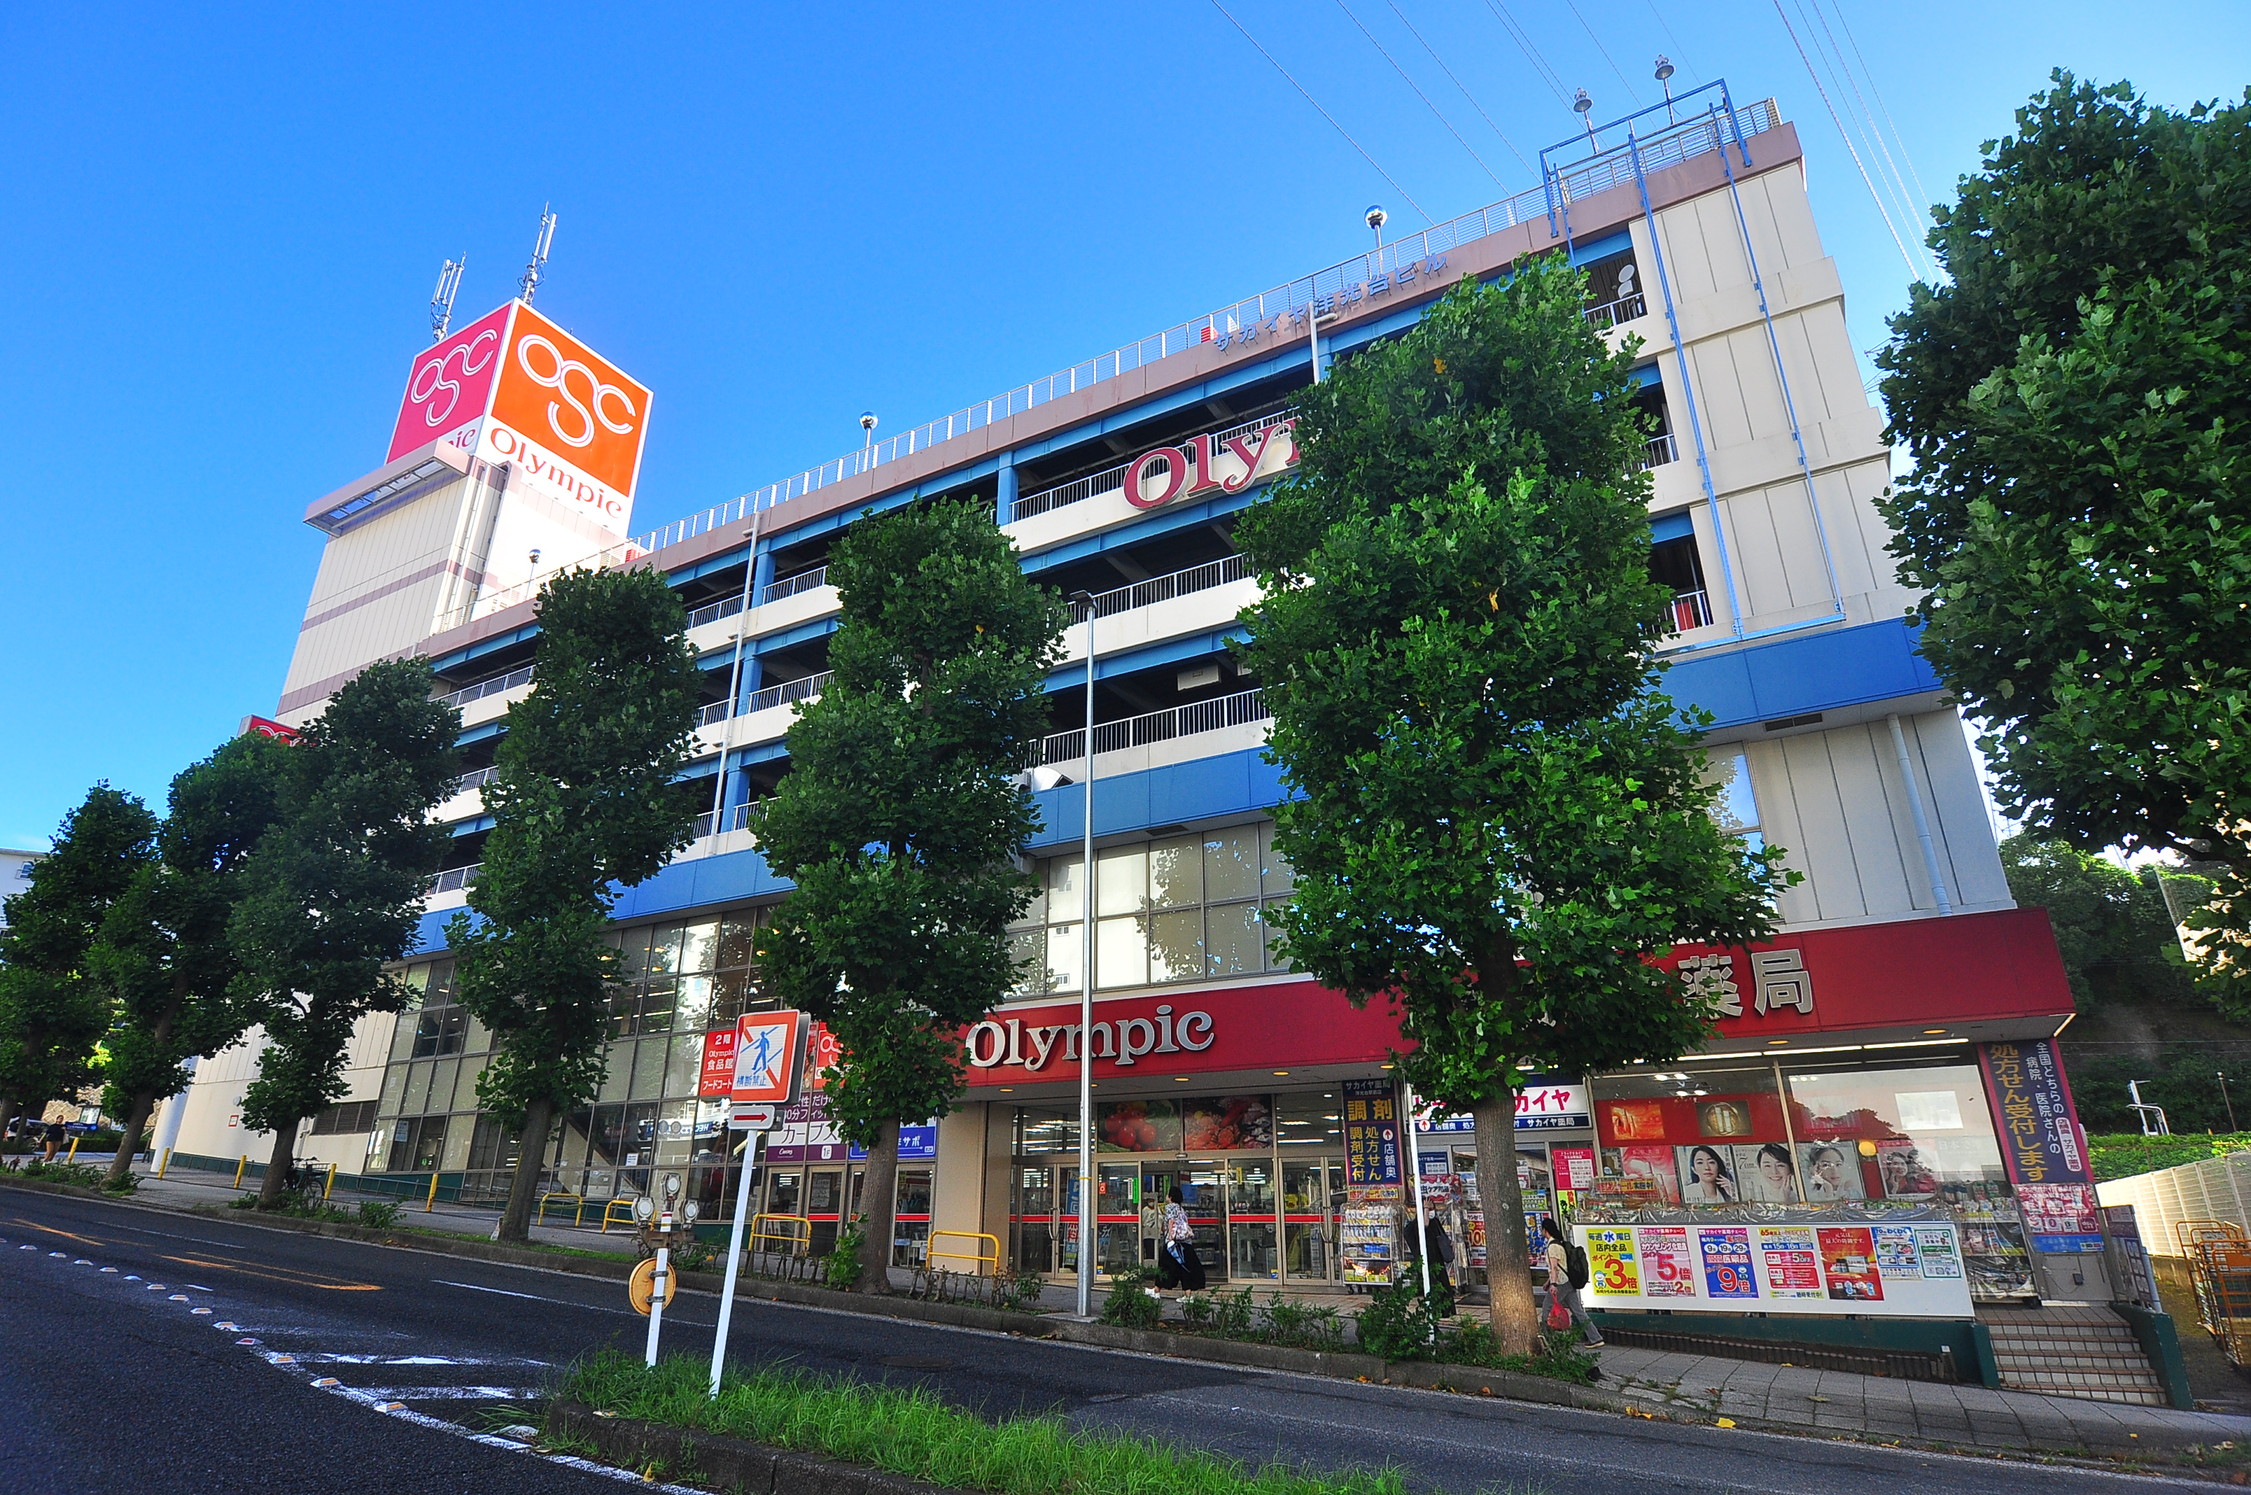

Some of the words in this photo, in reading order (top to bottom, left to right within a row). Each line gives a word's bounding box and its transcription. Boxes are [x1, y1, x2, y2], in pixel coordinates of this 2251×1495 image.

[490, 427, 623, 519] Olympic
[714, 1033, 731, 1045] 2階
[965, 1004, 1215, 1071] Olympic
[702, 1078, 733, 1091] フードコート
[736, 1074, 767, 1087] 横断禁止
[2036, 1041, 2065, 1115] 全国どちらの
[1526, 1117, 1575, 1127] サカイヤ薬局
[1990, 1044, 2048, 1182] 処方せん受付します
[2025, 1056, 2061, 1154] 病院・医院さんの
[1350, 1126, 1365, 1181] 調剤受付
[1366, 1126, 1382, 1182] 処方せん
[1383, 1143, 1397, 1178] 店舗奥
[1592, 1253, 1614, 1262] ポイント
[1595, 1243, 1627, 1252] 店内全品
